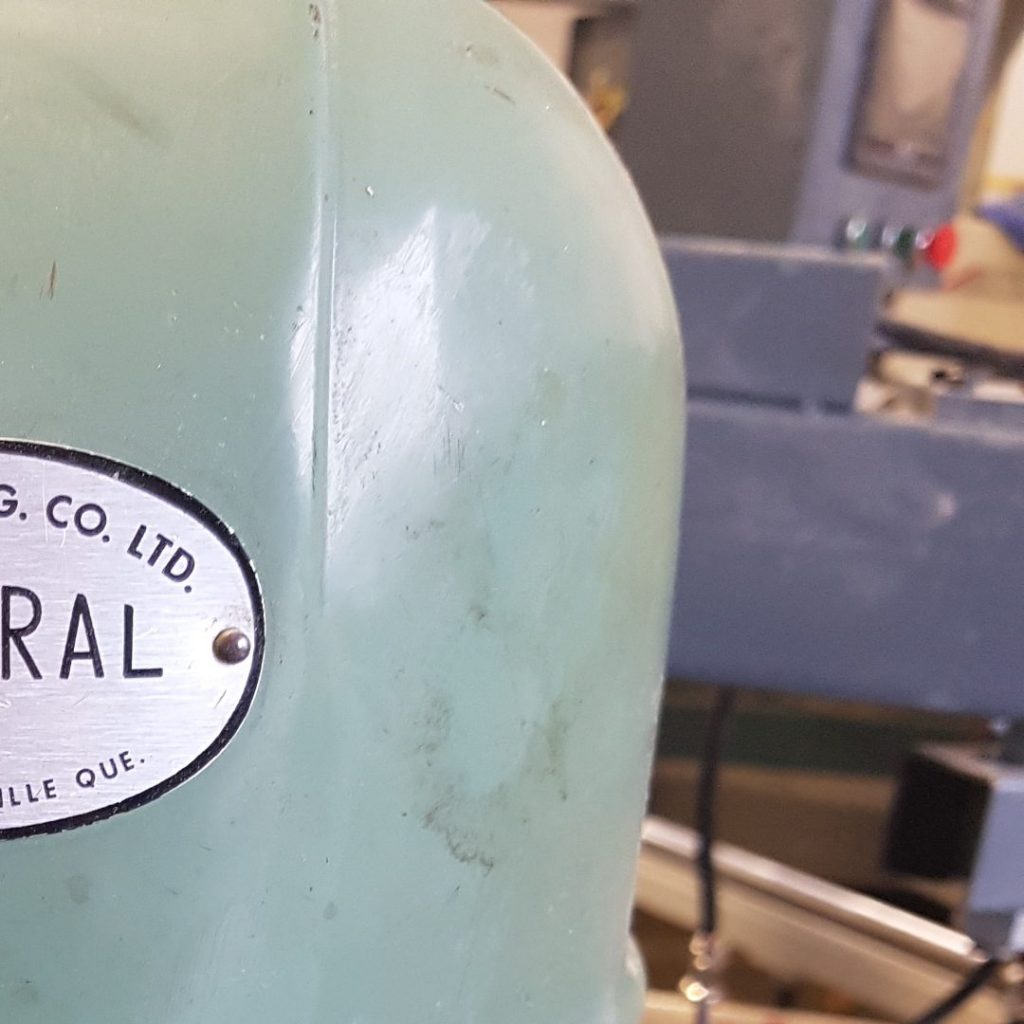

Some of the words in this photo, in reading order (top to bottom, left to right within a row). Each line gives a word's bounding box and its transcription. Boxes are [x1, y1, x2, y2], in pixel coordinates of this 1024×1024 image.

[46, 495, 111, 543] CO.
[127, 524, 195, 593] LTD.
[74, 750, 146, 789] QUE.
